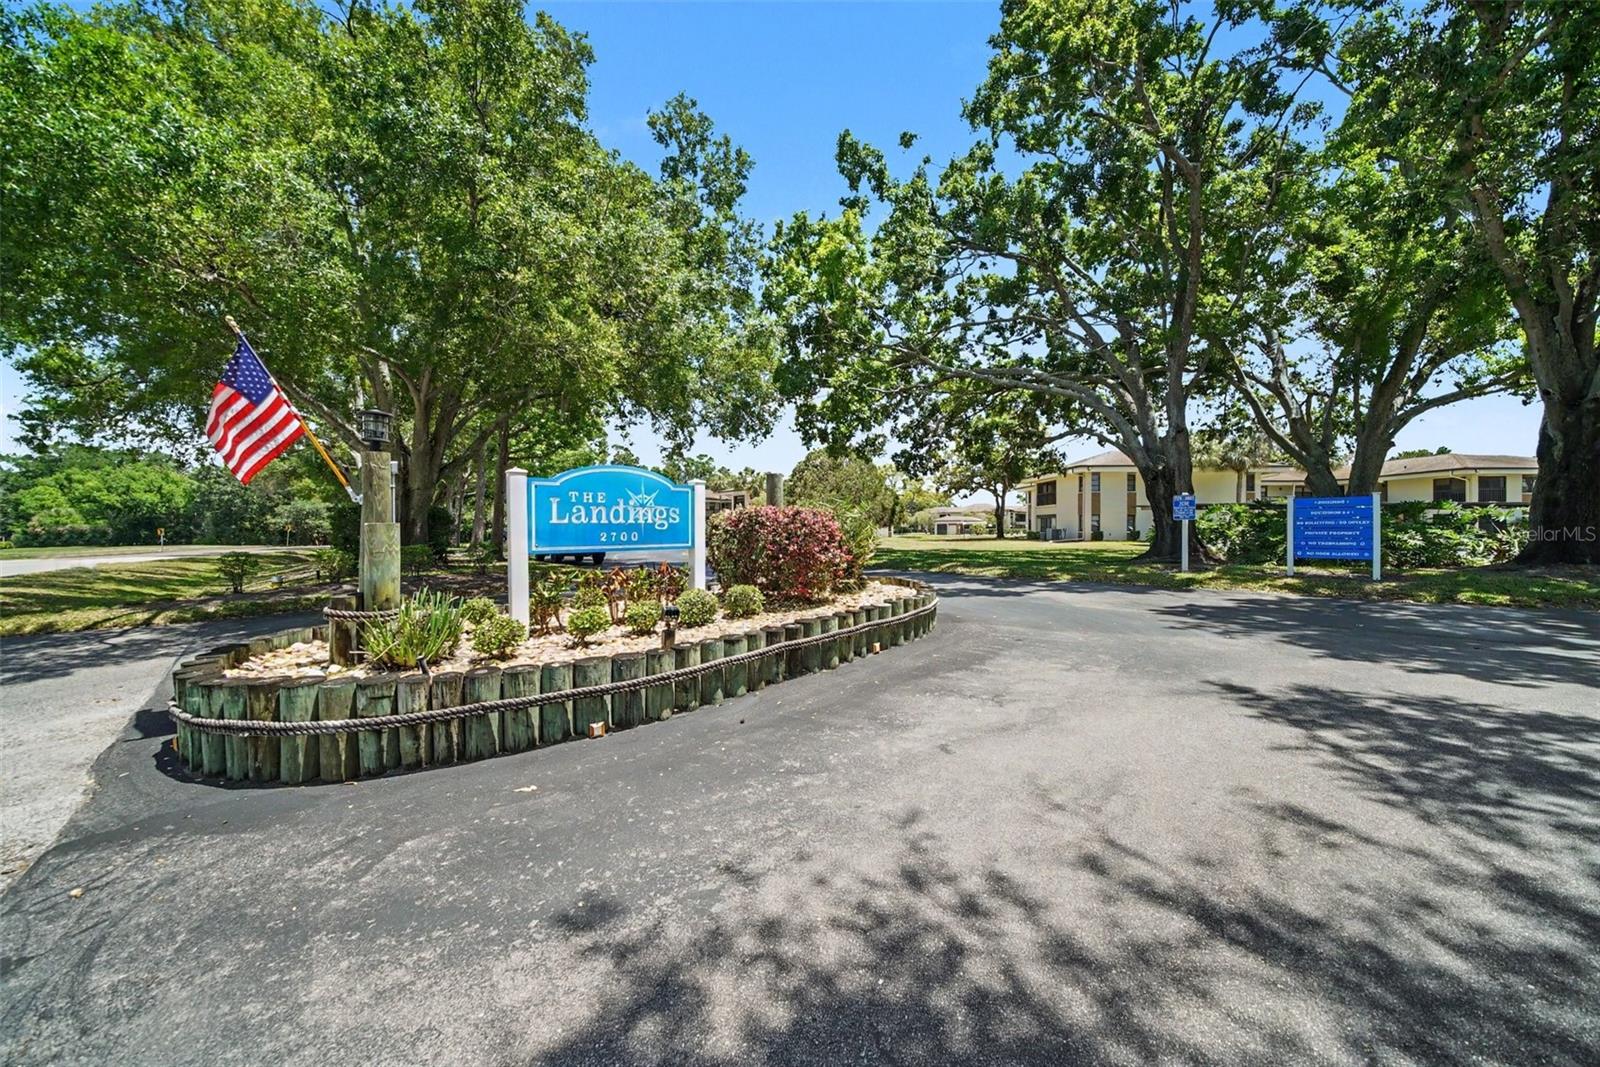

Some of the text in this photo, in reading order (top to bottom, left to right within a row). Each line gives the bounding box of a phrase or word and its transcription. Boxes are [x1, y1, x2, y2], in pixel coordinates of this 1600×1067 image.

[568, 491, 606, 503] THE
[548, 497, 680, 530] Landings
[600, 531, 639, 542] 2700
